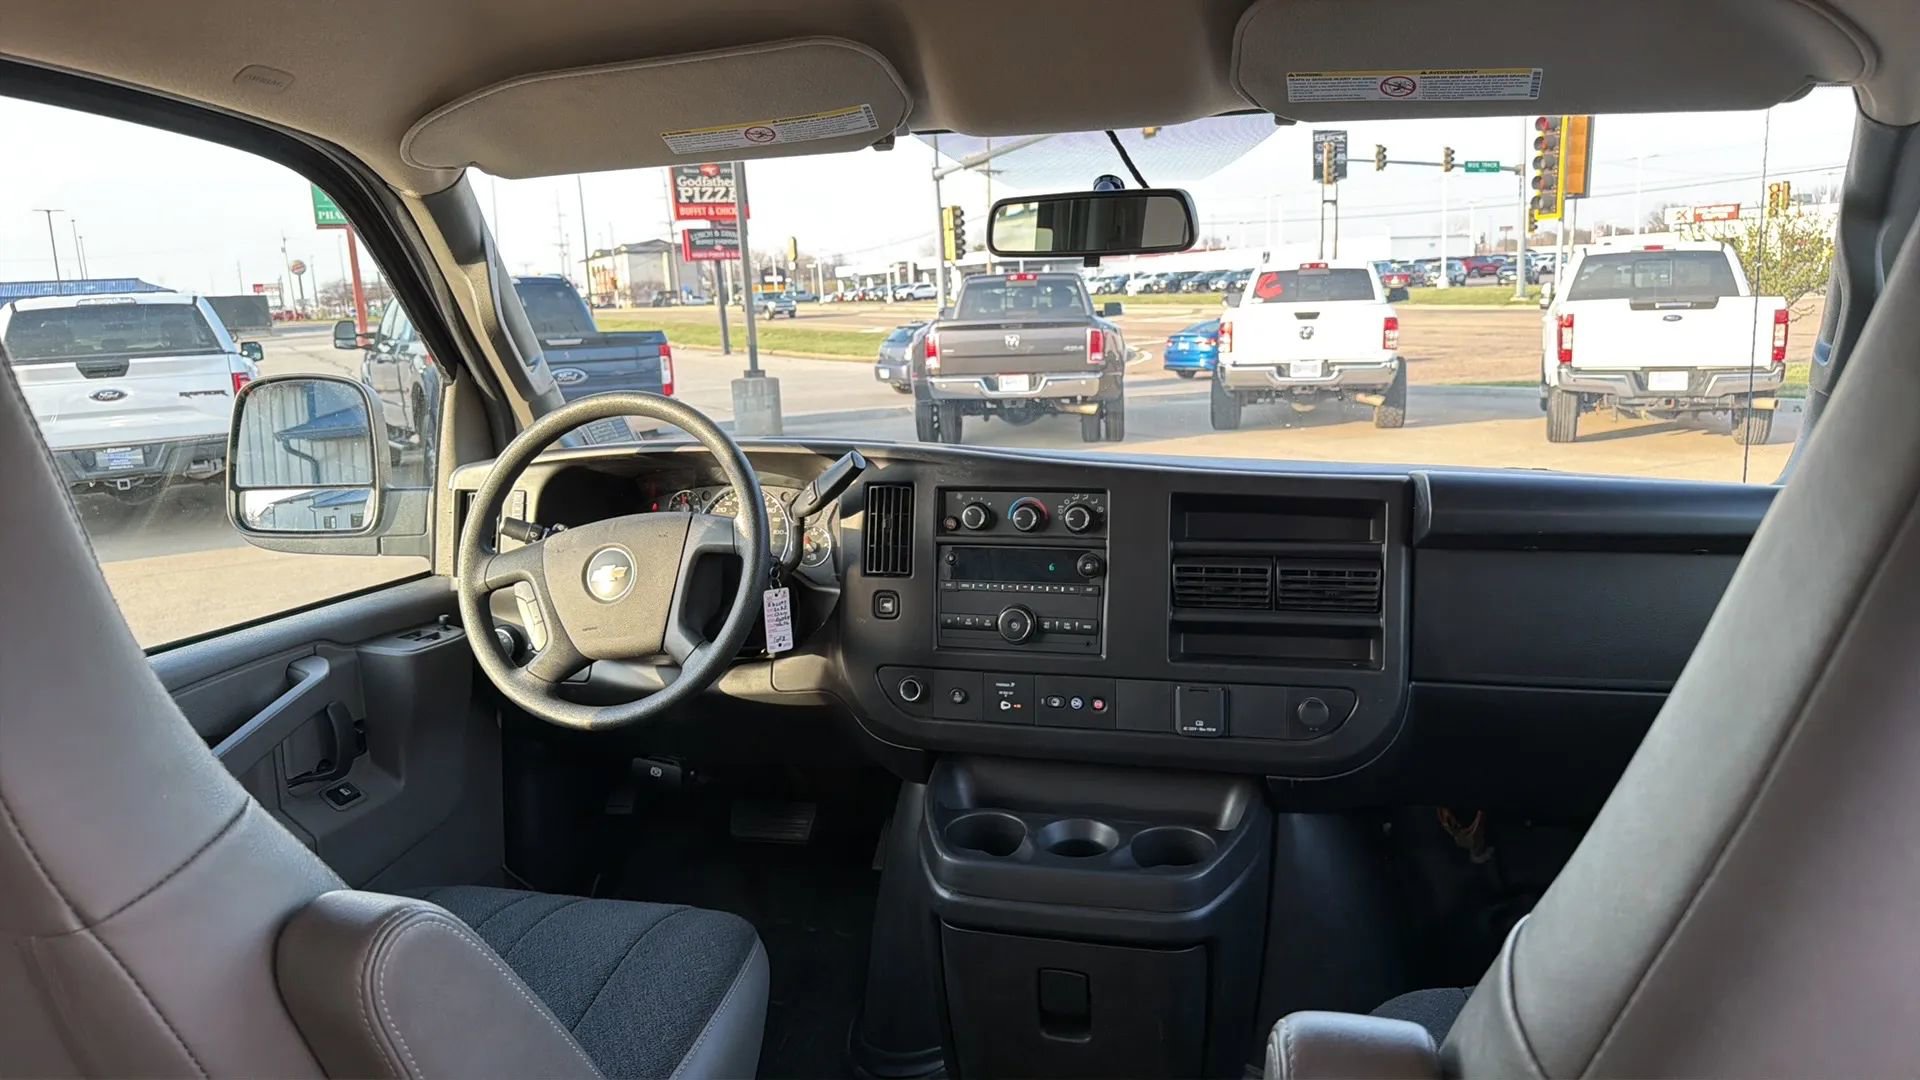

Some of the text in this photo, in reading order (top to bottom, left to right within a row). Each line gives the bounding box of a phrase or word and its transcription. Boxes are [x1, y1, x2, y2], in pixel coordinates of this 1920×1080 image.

[557, 371, 578, 381] Ford
[98, 391, 120, 400] Ford
[179, 389, 228, 399] RAPTOR
[1048, 562, 1055, 571] 6
